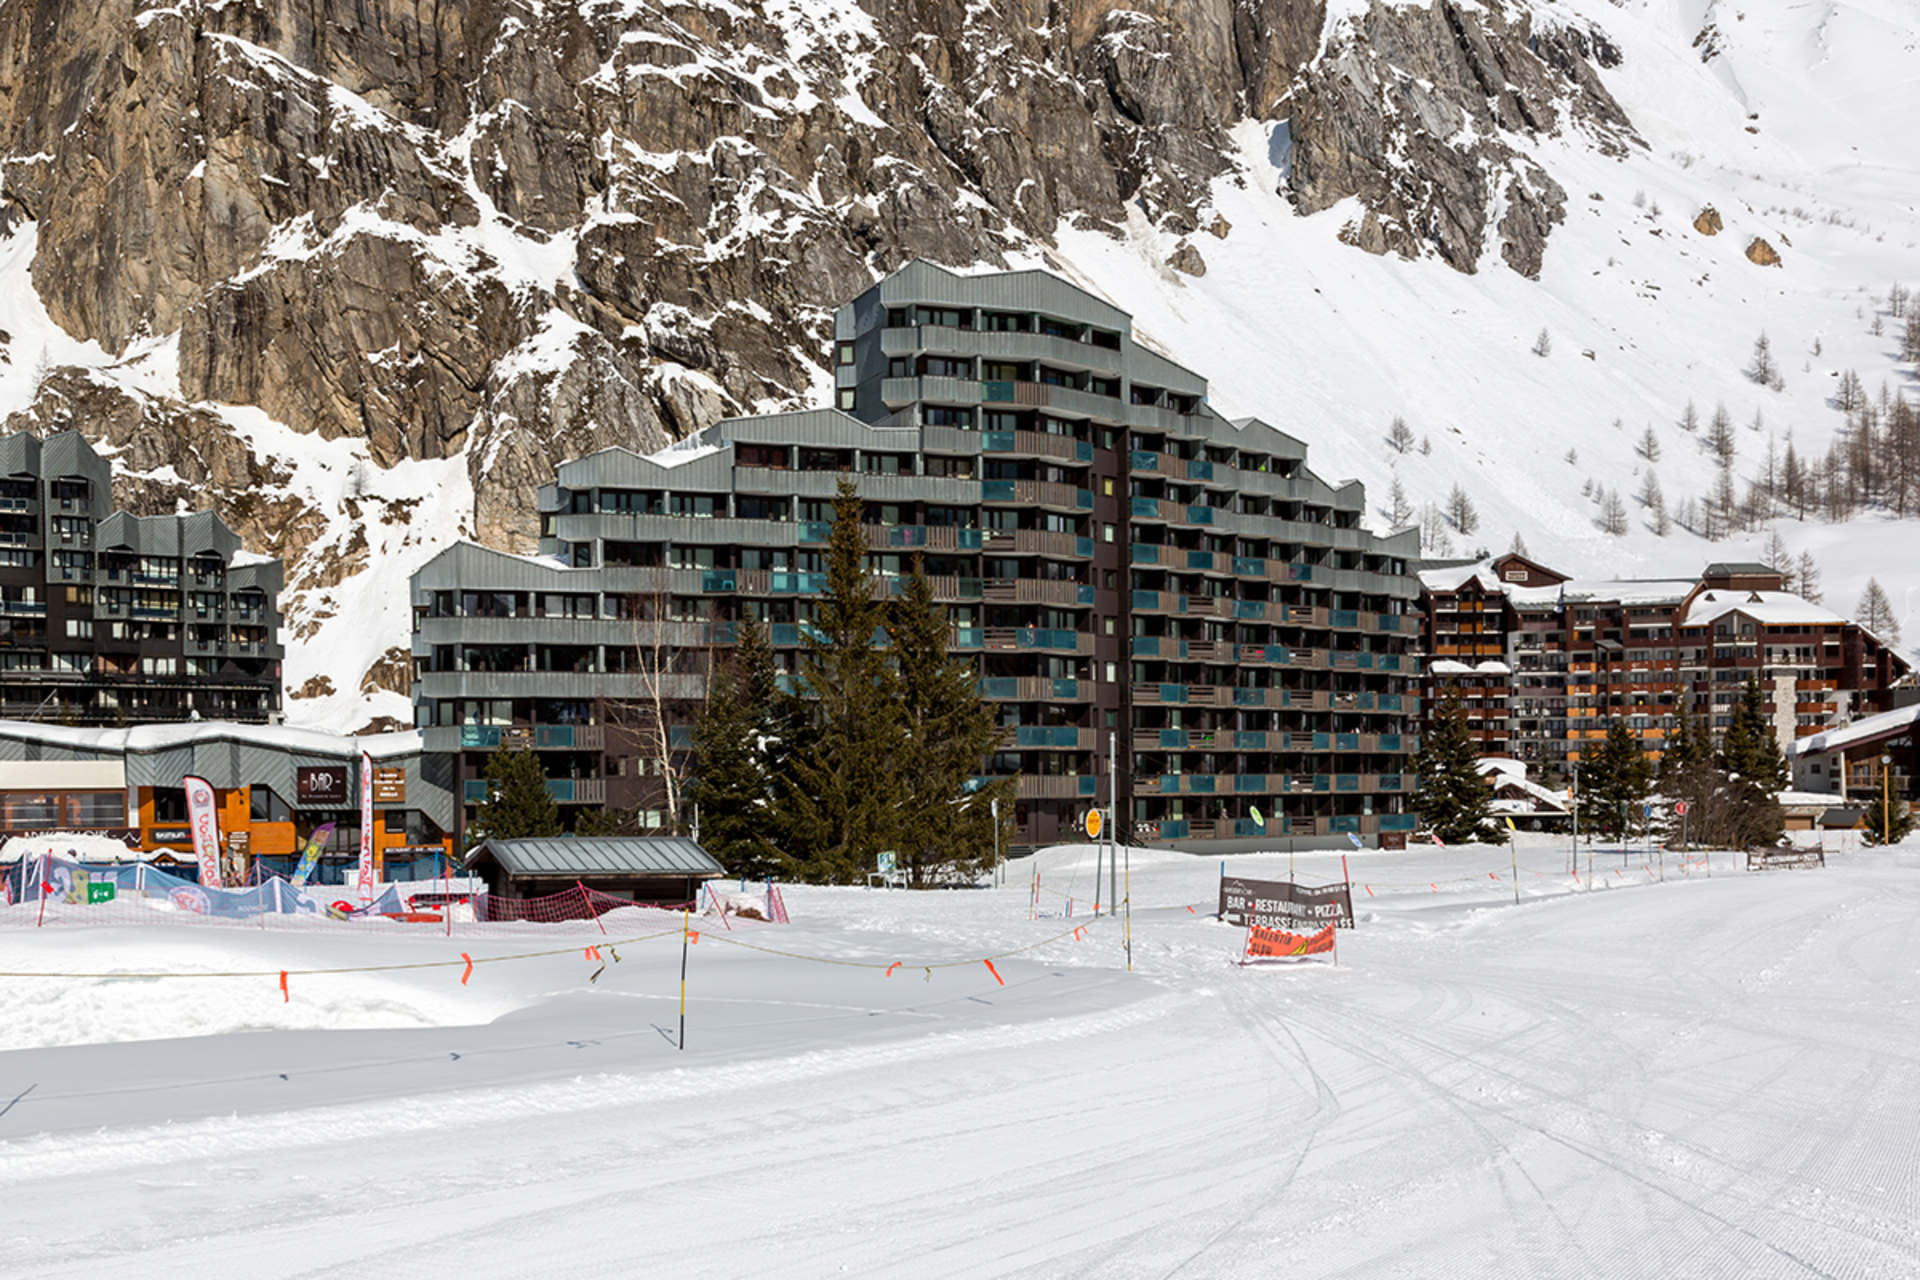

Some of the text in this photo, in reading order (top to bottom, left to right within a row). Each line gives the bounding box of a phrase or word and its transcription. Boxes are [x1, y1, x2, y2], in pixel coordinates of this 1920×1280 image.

[310, 772, 333, 792] BAR
[1227, 896, 1344, 917] BAR RESTAURANT PIZZA
